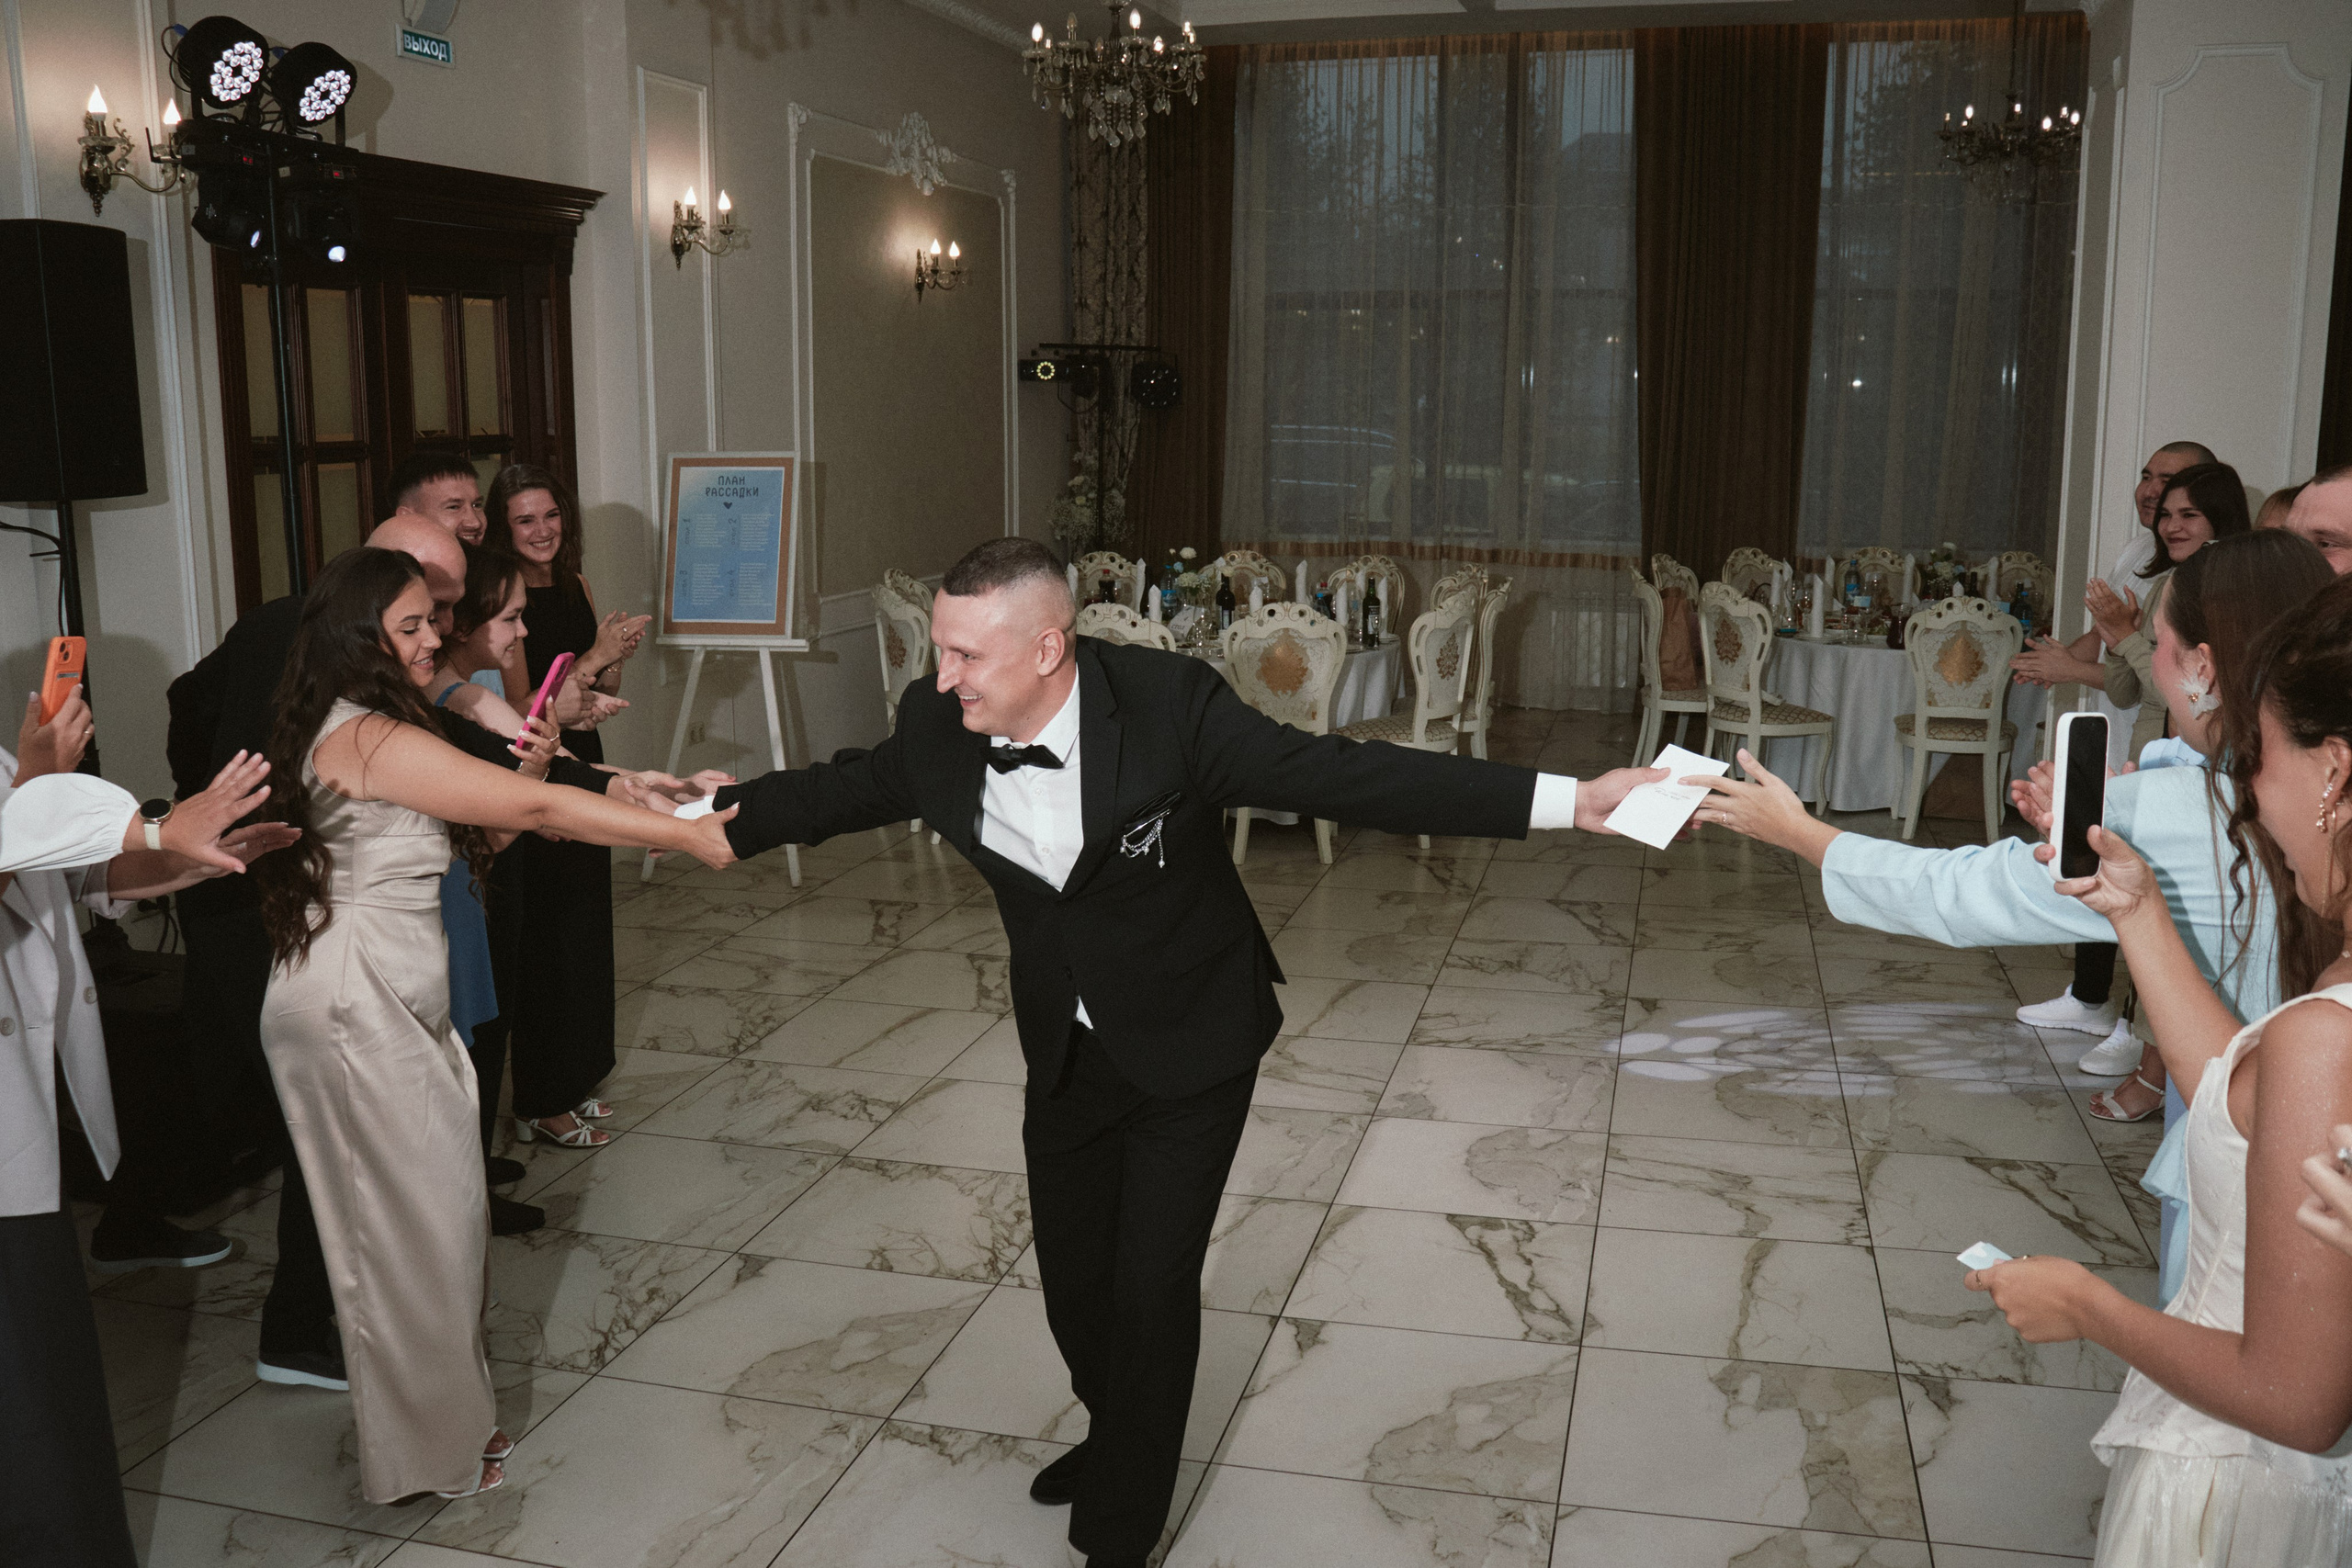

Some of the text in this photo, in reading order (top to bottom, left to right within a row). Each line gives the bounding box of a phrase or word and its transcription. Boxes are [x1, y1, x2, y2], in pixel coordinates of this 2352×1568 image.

[403, 33, 447, 61] ВЫХОД
[718, 475, 745, 486] ПЛАН
[705, 487, 759, 499] РАССАДКИ
